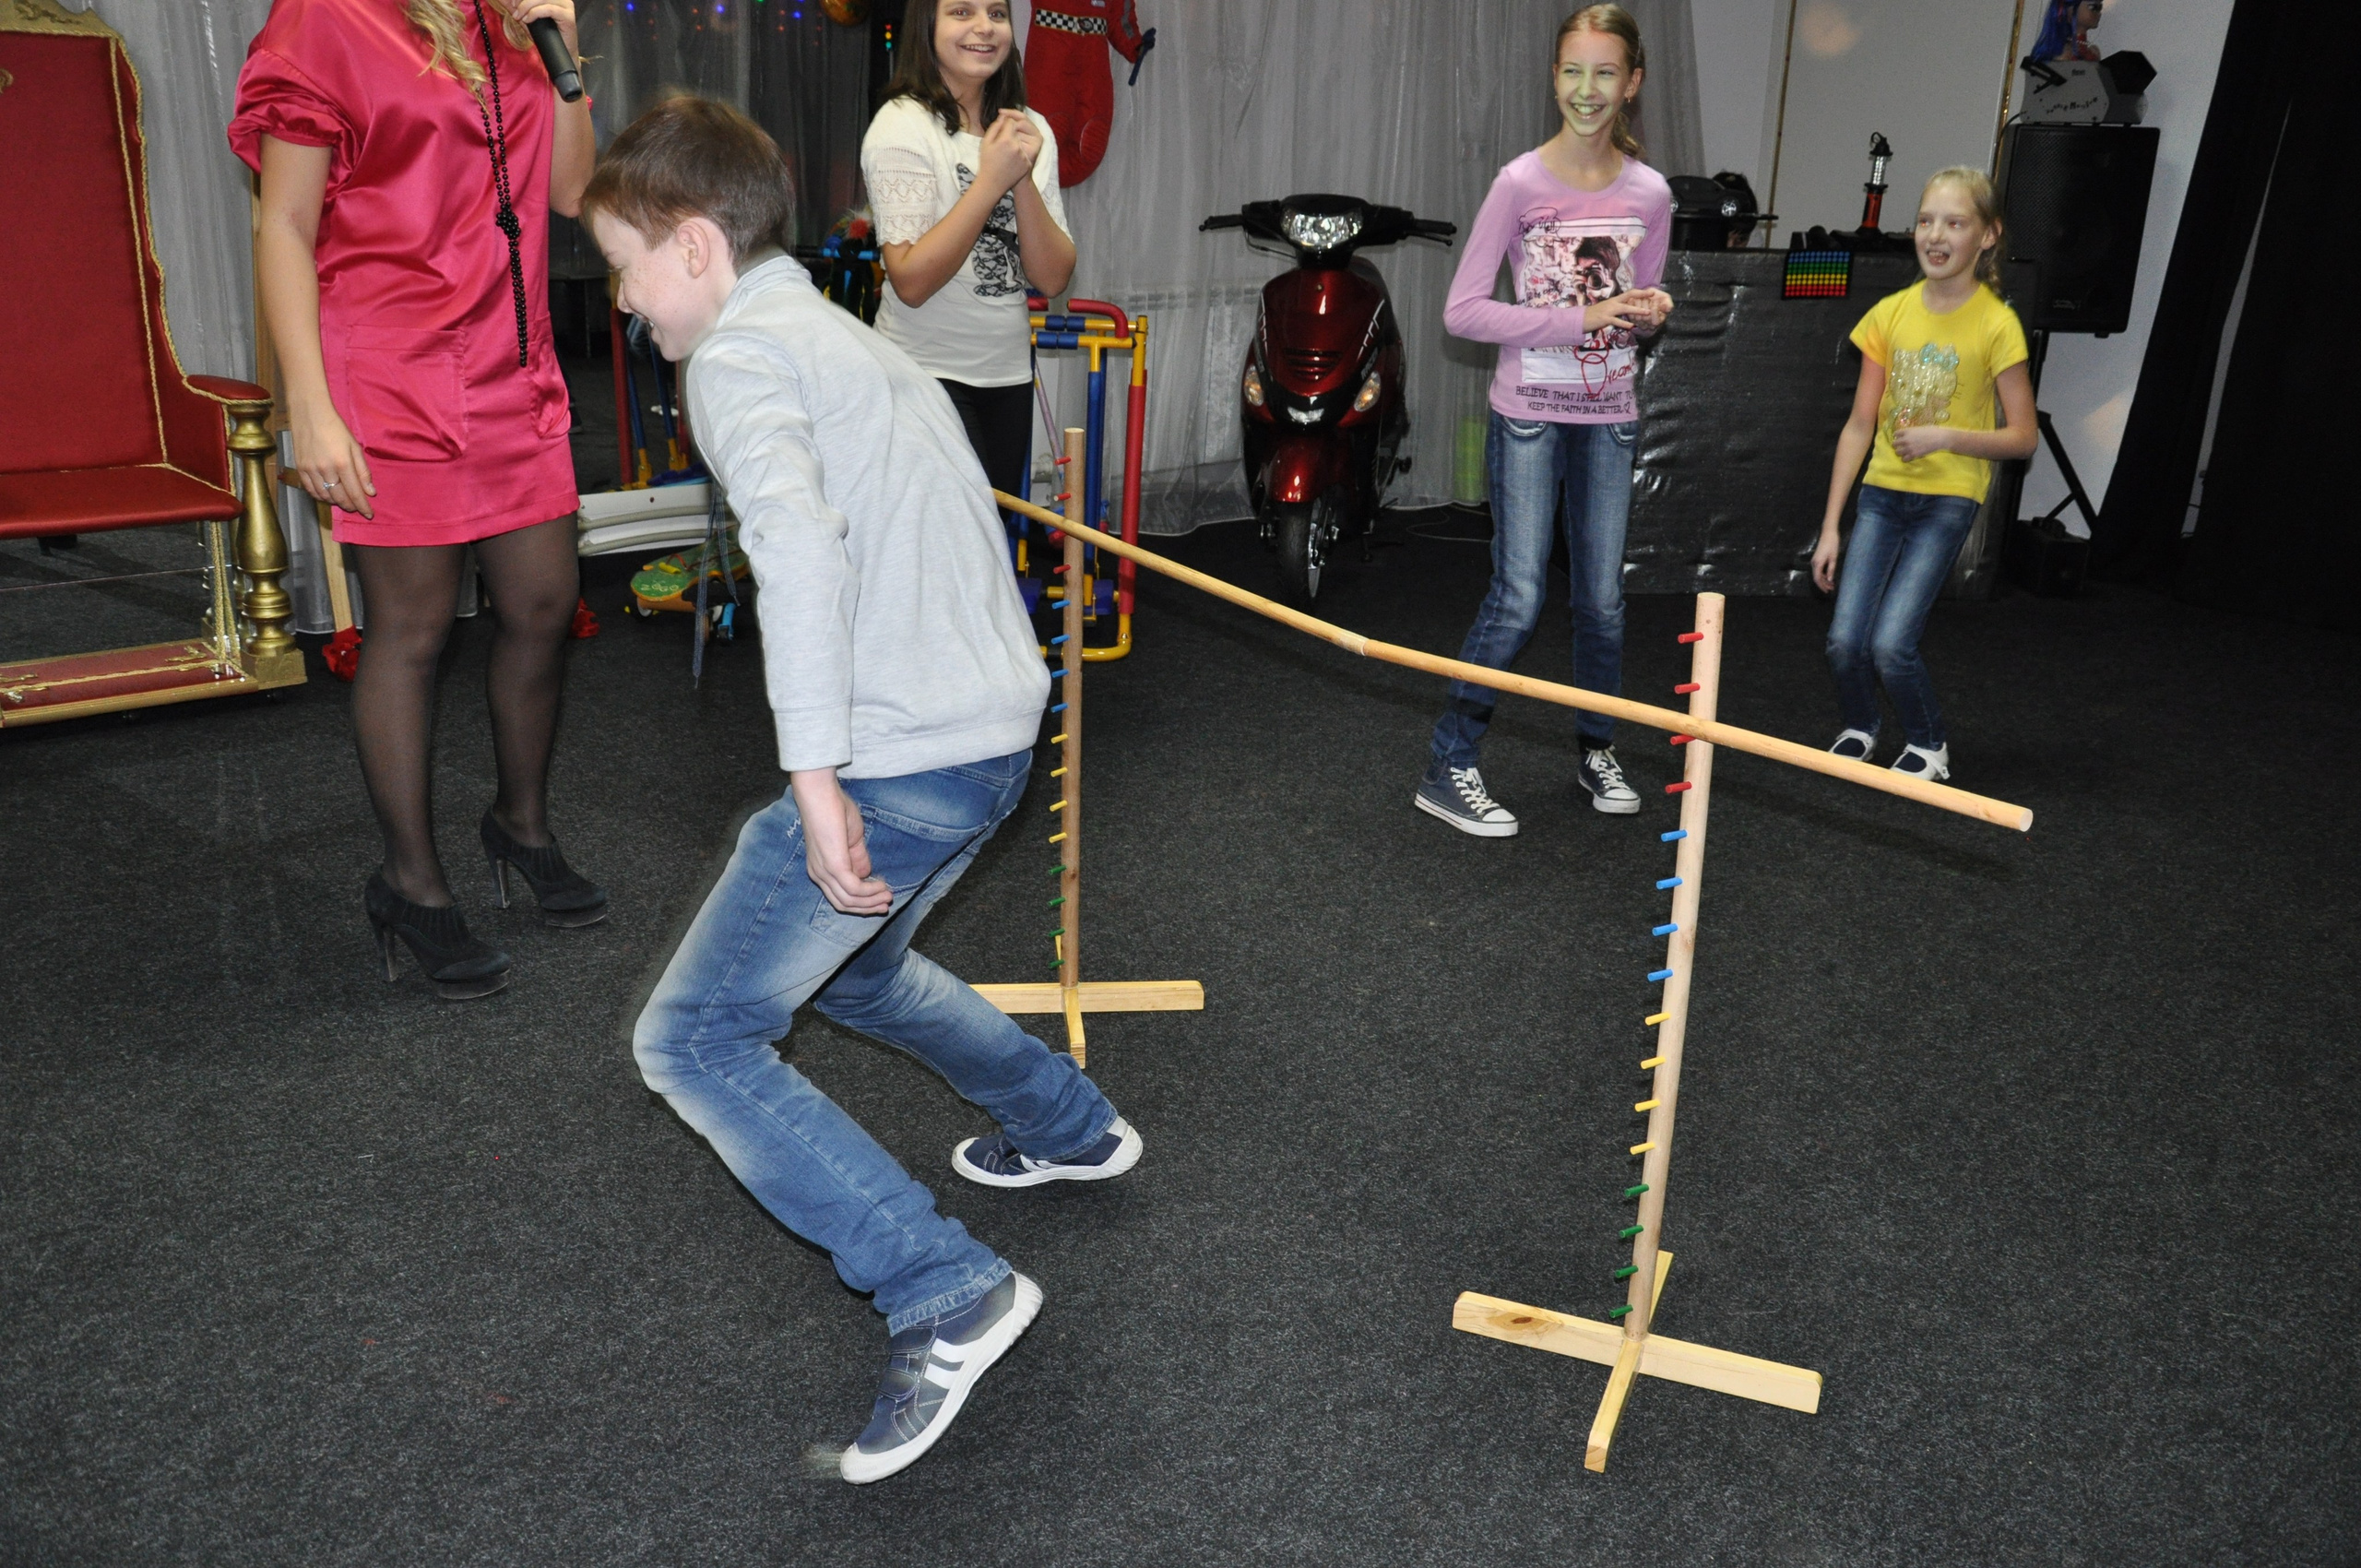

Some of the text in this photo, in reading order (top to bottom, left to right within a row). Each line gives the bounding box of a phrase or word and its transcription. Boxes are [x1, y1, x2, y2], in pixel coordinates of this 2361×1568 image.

[1515, 386, 1549, 398] BELIEVE
[1552, 390, 1575, 401] THAT
[1603, 391, 1623, 403] WANT
[1527, 401, 1622, 414] KEEP THE FAITH IN A BETTER
